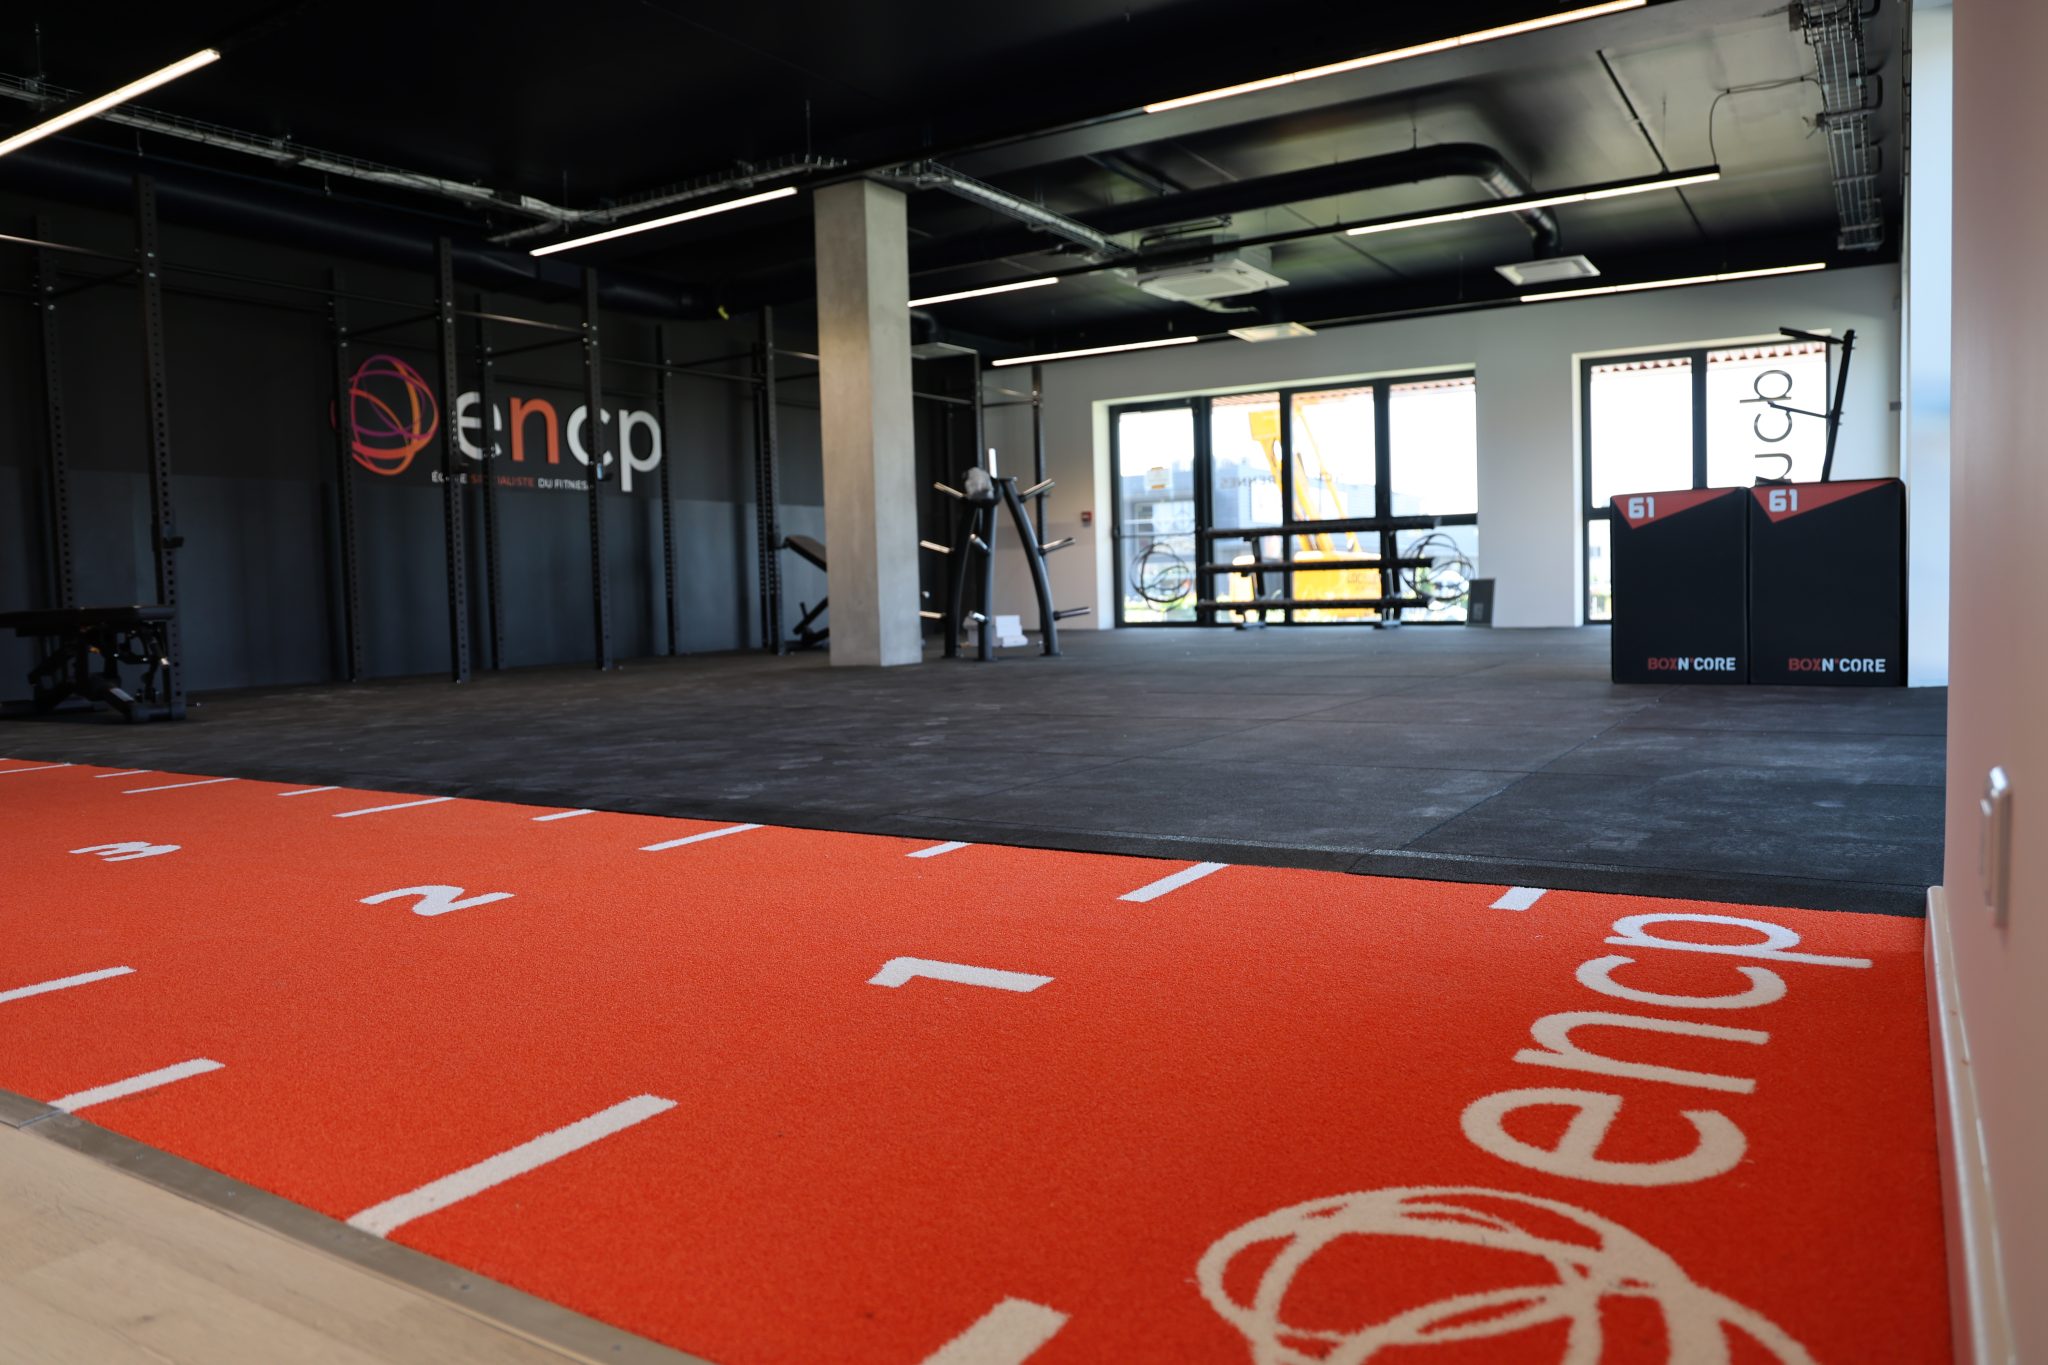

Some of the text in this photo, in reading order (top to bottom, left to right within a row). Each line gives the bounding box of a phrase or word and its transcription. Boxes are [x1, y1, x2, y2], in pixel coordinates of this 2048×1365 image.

[456, 391, 662, 492] encp
[537, 478, 554, 489] DU
[554, 478, 589, 491] FITNES
[1628, 496, 1655, 519] 61
[1768, 488, 1798, 512] 61
[69, 841, 182, 862] 3
[359, 885, 514, 917] 2
[867, 956, 1054, 992] 1
[1460, 912, 1873, 1186] encp
